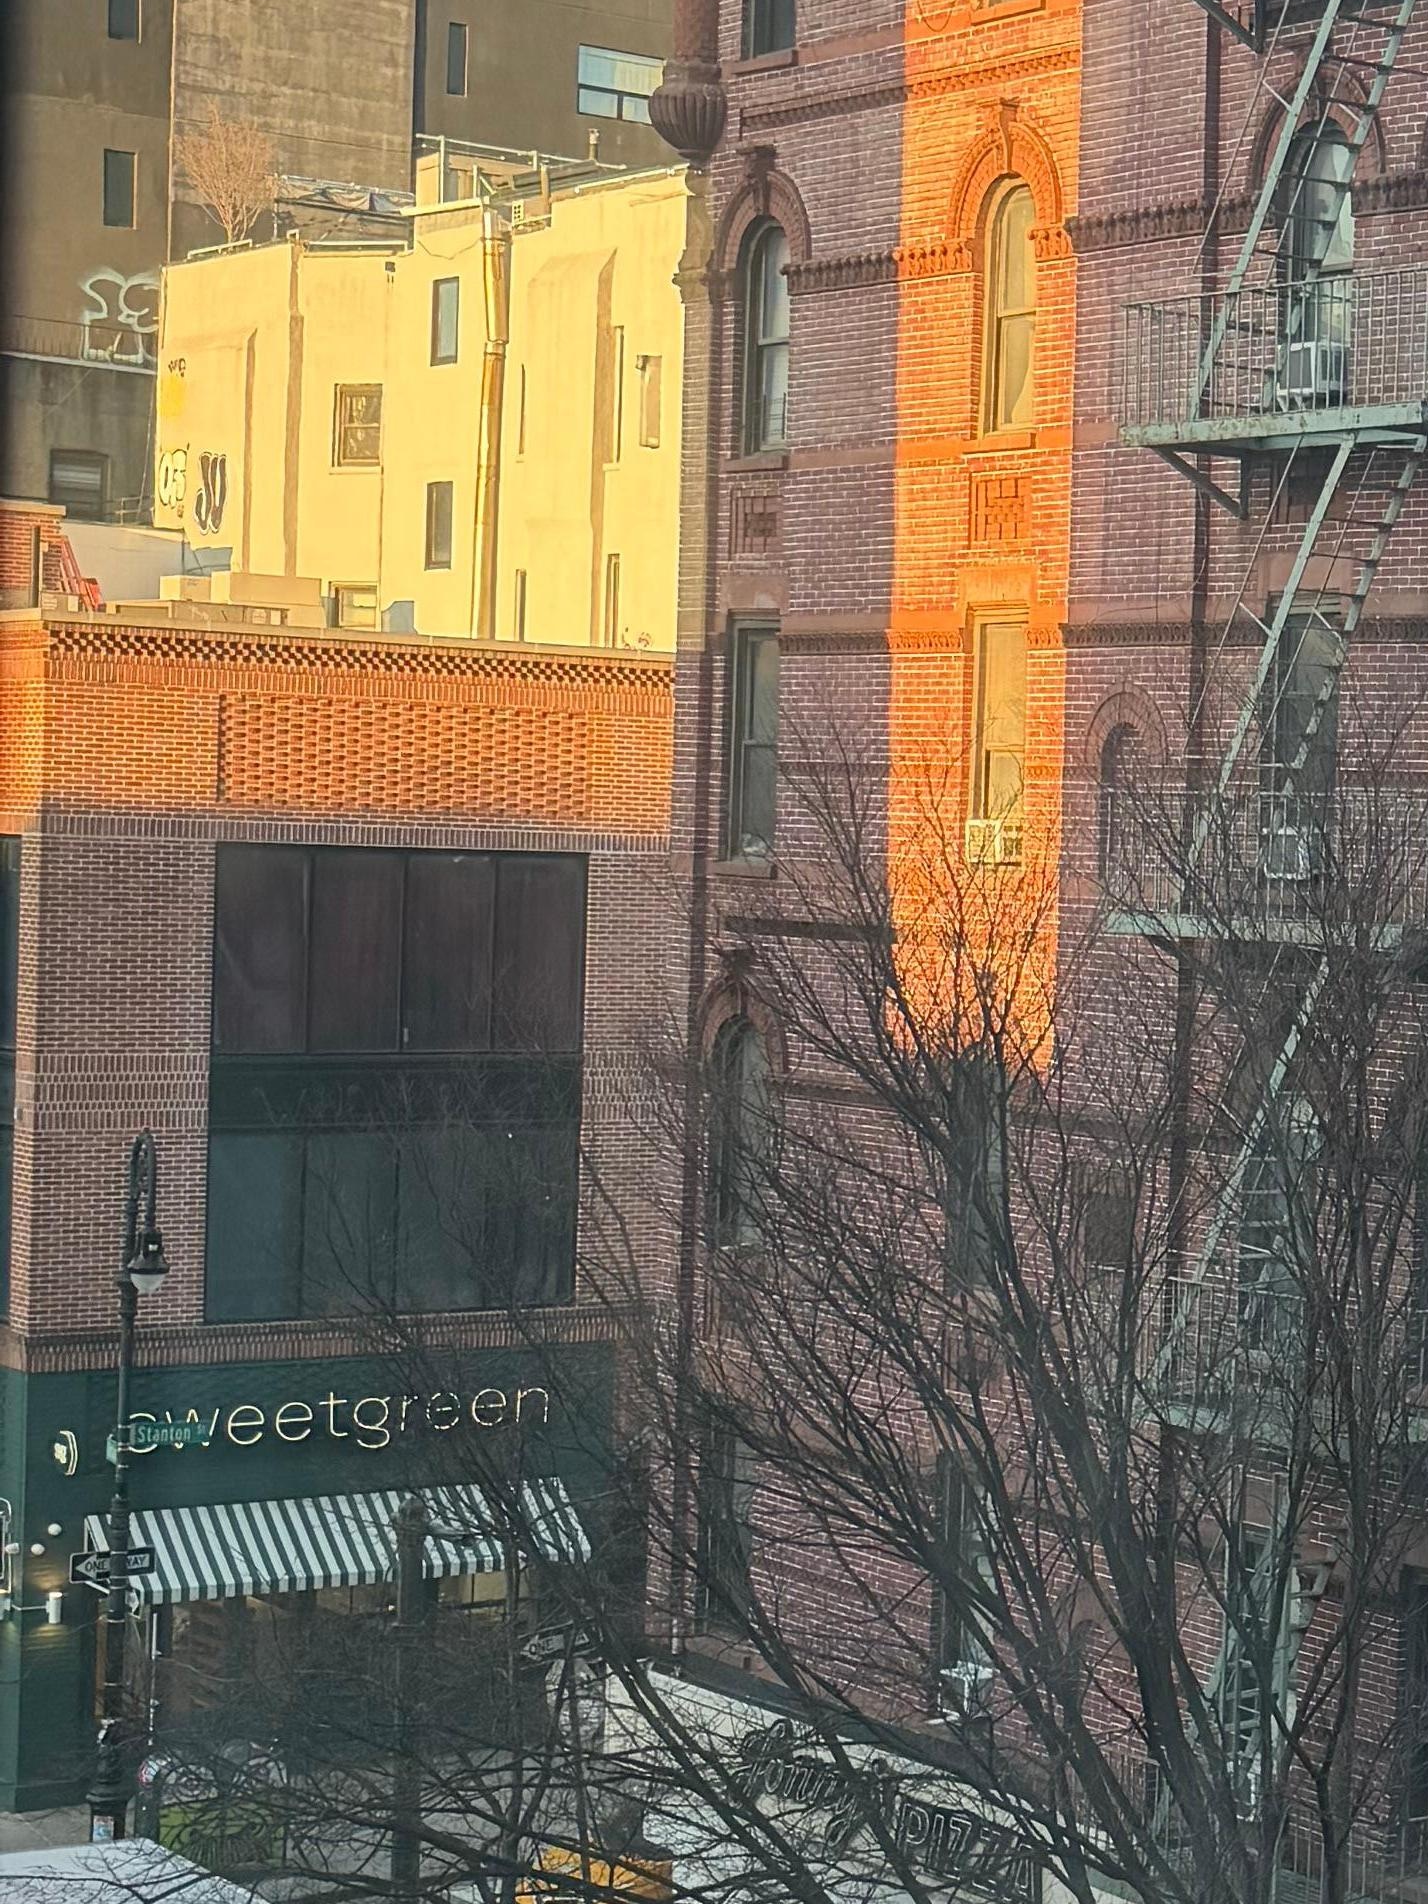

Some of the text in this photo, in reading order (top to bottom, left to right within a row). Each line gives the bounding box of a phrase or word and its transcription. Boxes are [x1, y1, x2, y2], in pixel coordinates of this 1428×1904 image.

[128, 1386, 549, 1454] sweetgreen
[137, 1425, 192, 1444] Stanton
[84, 1559, 106, 1573] ONE
